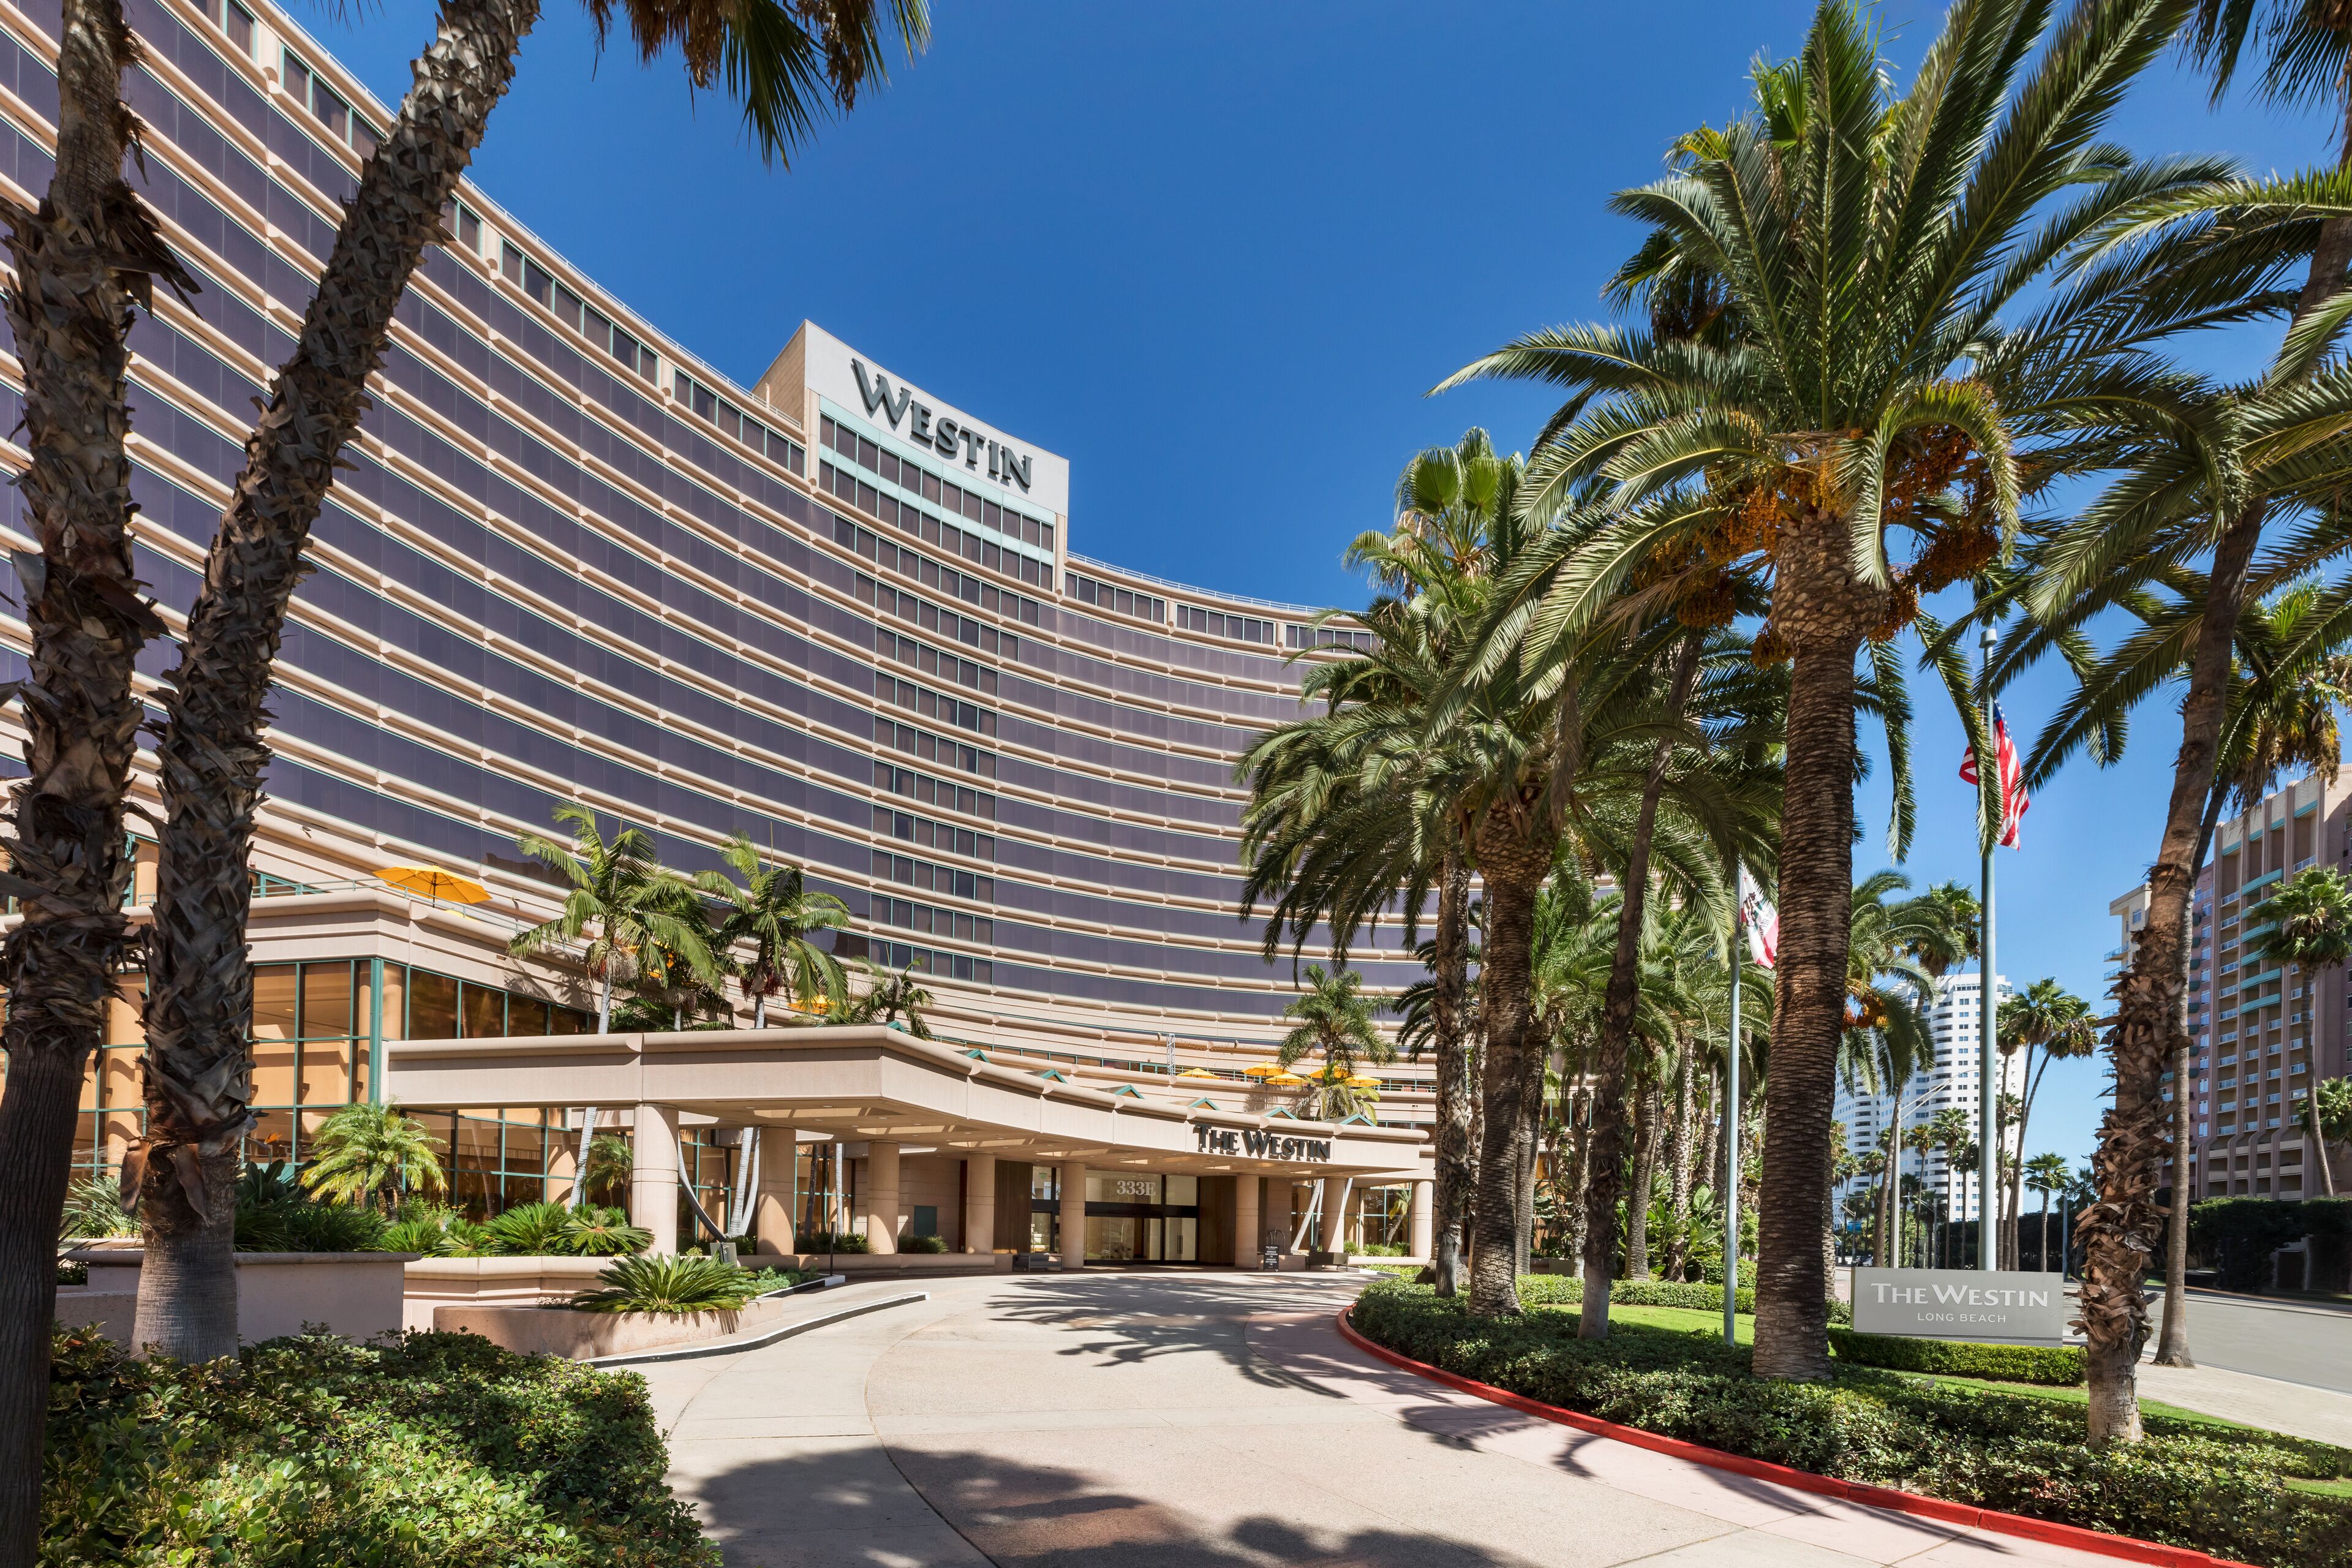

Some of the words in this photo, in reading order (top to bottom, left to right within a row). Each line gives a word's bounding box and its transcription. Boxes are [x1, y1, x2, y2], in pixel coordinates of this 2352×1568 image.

[851, 358, 1033, 489] WESTIN
[1194, 1123, 1240, 1152] THE
[1242, 1128, 1331, 1159] WESTIN
[1117, 1180, 1156, 1196] 333E
[1871, 1283, 1928, 1303] THE
[1931, 1284, 2048, 1307] WESTIN
[1917, 1313, 1954, 1322] LONG
[1960, 1314, 2006, 1323] BEACH
